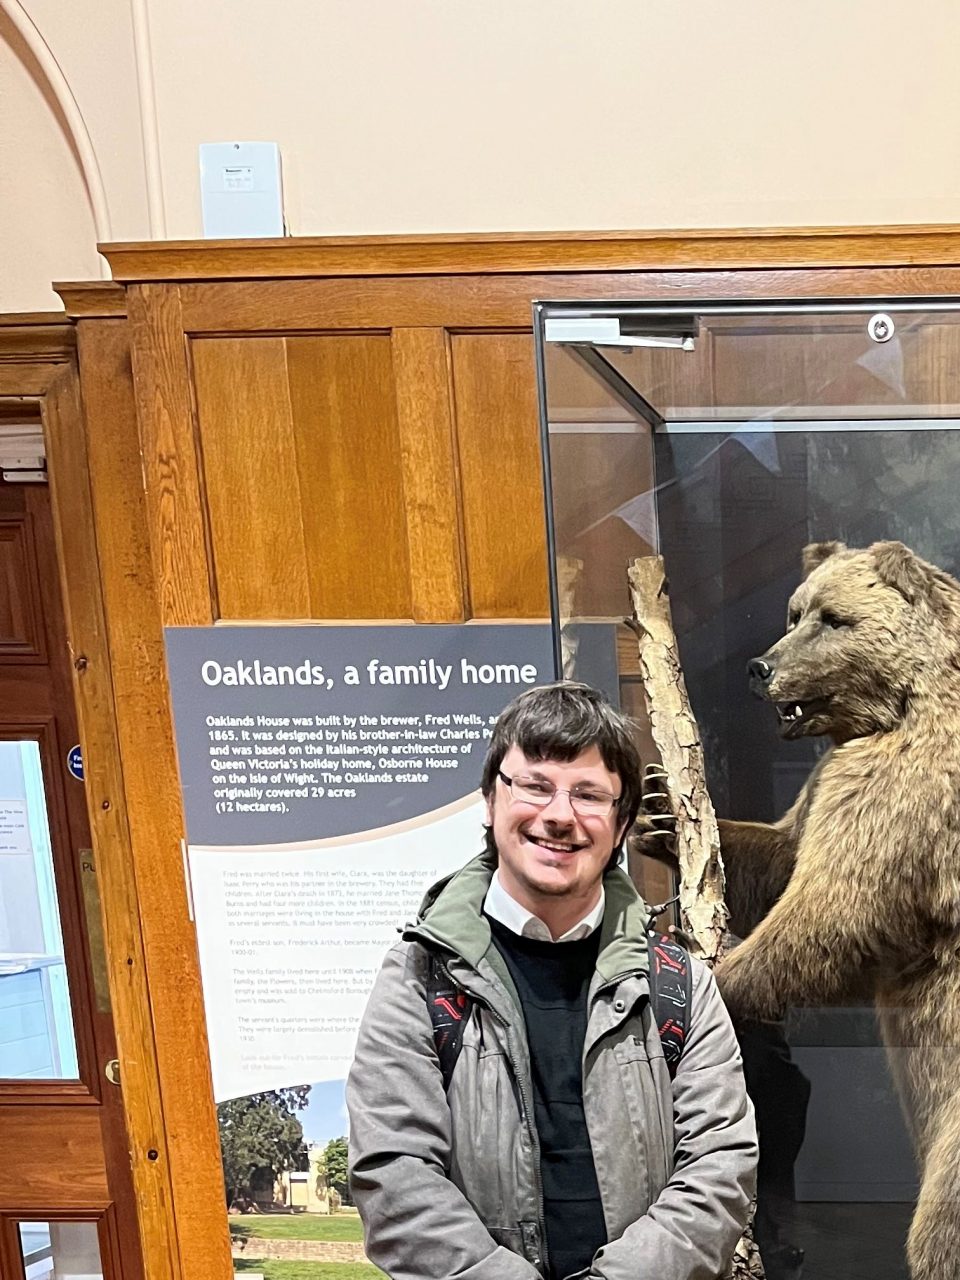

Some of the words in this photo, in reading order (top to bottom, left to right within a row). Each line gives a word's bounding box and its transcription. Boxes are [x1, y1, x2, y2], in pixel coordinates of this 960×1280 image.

[201, 660, 334, 691] Oaklands,
[344, 665, 359, 685] a
[367, 659, 452, 691] family
[461, 659, 537, 685] home
[205, 715, 254, 727] Oaklands
[256, 715, 290, 726] House
[292, 717, 313, 726] was
[315, 715, 341, 726] built
[342, 714, 356, 728] by
[359, 714, 378, 726] the
[380, 716, 422, 726] brewer,
[424, 714, 450, 725] Fred
[452, 713, 485, 726] Wells,
[488, 716, 497, 725] an
[208, 730, 238, 741] 1865.
[241, 729, 250, 741] It
[252, 732, 273, 741] was
[275, 729, 323, 742] designed
[325, 729, 338, 743] by
[341, 729, 357, 740] his
[359, 729, 437, 740] brother-in-law
[439, 728, 480, 739] Charles
[209, 744, 229, 755] and
[231, 746, 252, 755] was
[254, 744, 286, 755] based
[288, 746, 302, 755] on
[304, 744, 323, 755] the
[325, 743, 388, 755] Italian-style
[391, 743, 458, 754] architecture
[460, 742, 472, 754] of
[210, 758, 245, 771] Queen
[247, 758, 298, 769] Victoria's
[300, 758, 339, 771] holiday
[341, 758, 375, 770] home,
[378, 757, 422, 768] Osborne
[425, 757, 458, 768] House
[212, 775, 226, 784] on
[228, 773, 247, 784] the
[249, 773, 267, 784] Isle
[270, 772, 281, 784] of
[283, 772, 318, 786] Wight.
[320, 772, 342, 783] The
[344, 772, 393, 783] Oaklands
[395, 773, 428, 783] estate
[213, 787, 263, 800] originally
[265, 788, 308, 798] covered
[311, 786, 324, 798] 29
[327, 788, 356, 798] acres
[215, 801, 233, 814] (12
[235, 802, 289, 812] hectares).
[82, 862, 96, 873] PU
